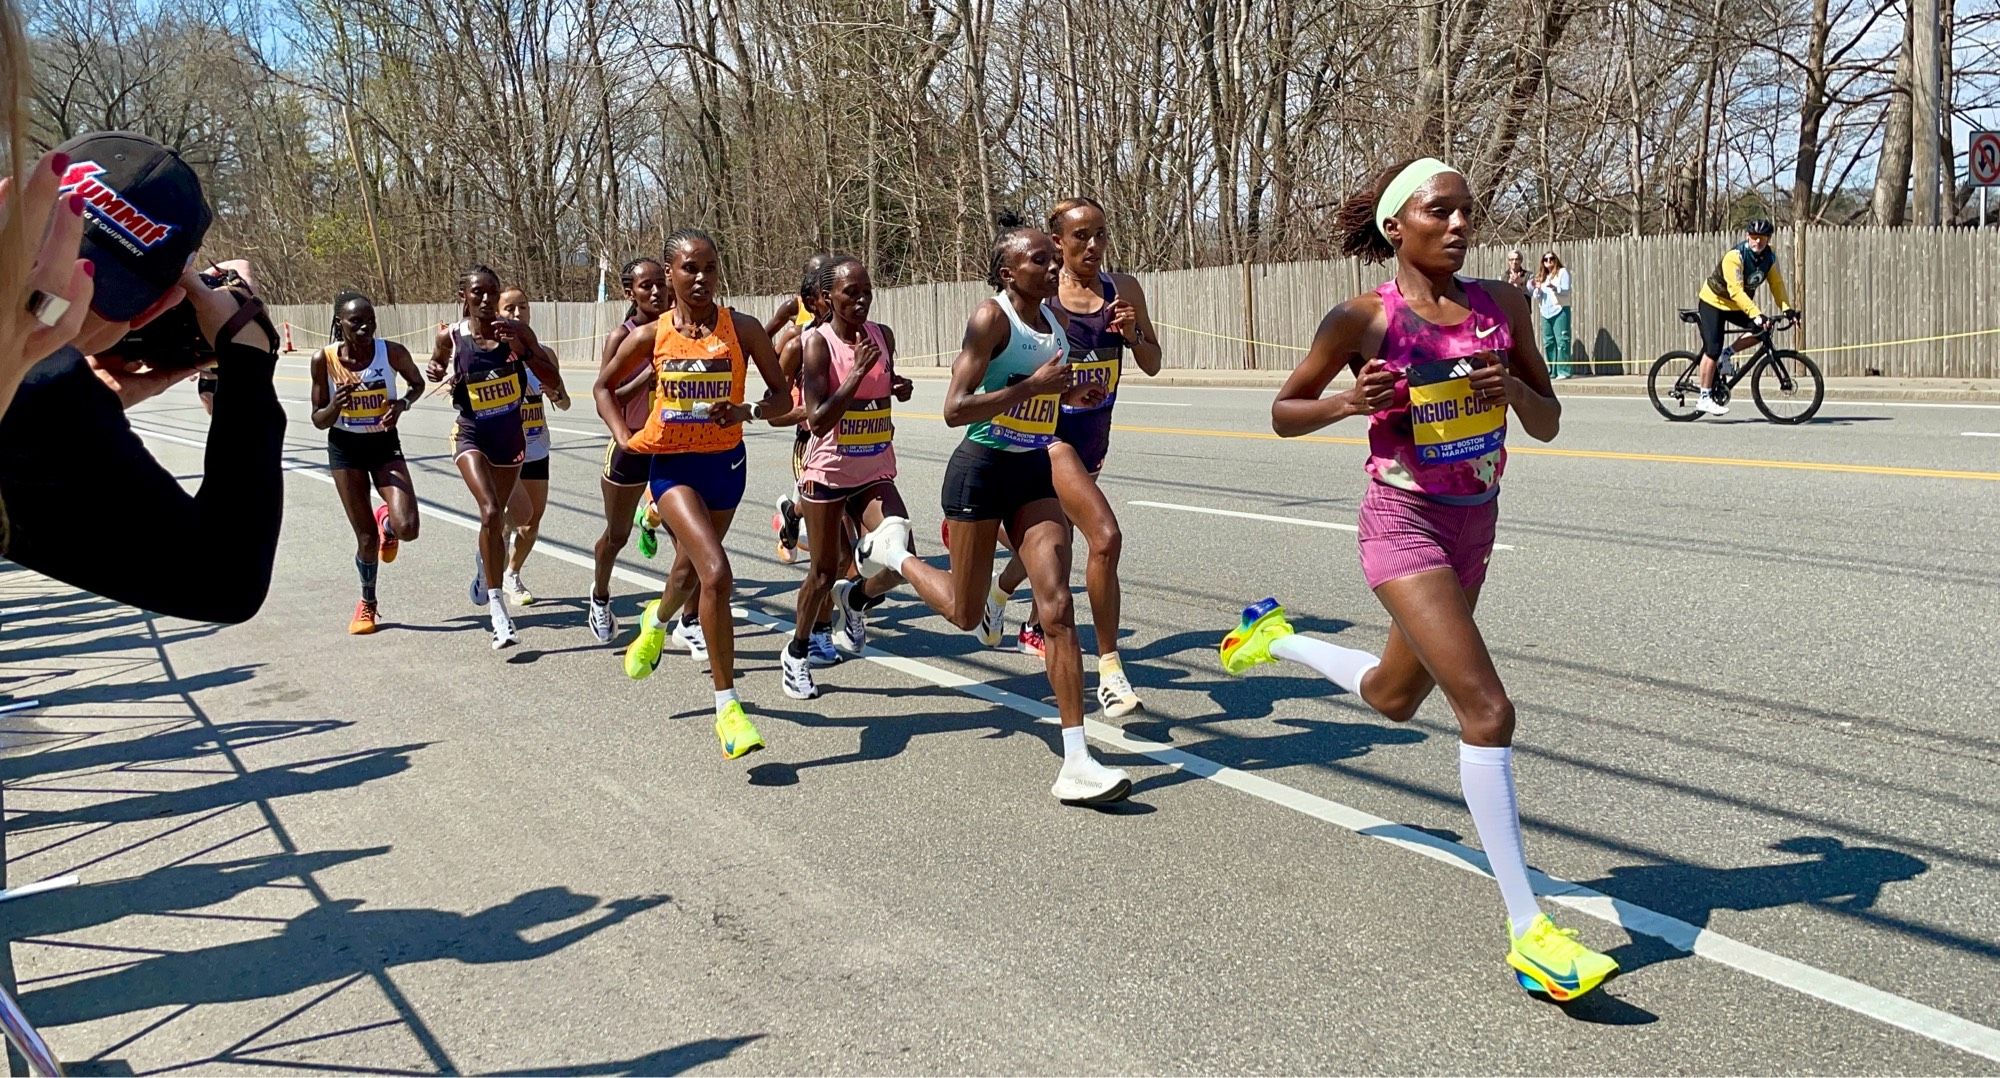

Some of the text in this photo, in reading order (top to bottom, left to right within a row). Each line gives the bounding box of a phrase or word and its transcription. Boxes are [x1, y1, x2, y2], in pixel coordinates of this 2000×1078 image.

[91, 217, 145, 257] EQUIPMENT
[1021, 343, 1038, 352] OAC
[475, 380, 516, 403] TEFERI
[660, 380, 732, 400] YESHANEH
[521, 406, 543, 422] DADI
[1004, 398, 1057, 423] ELLEN
[1441, 443, 1485, 458] MARATHON
[1457, 436, 1485, 447] BOSTON
